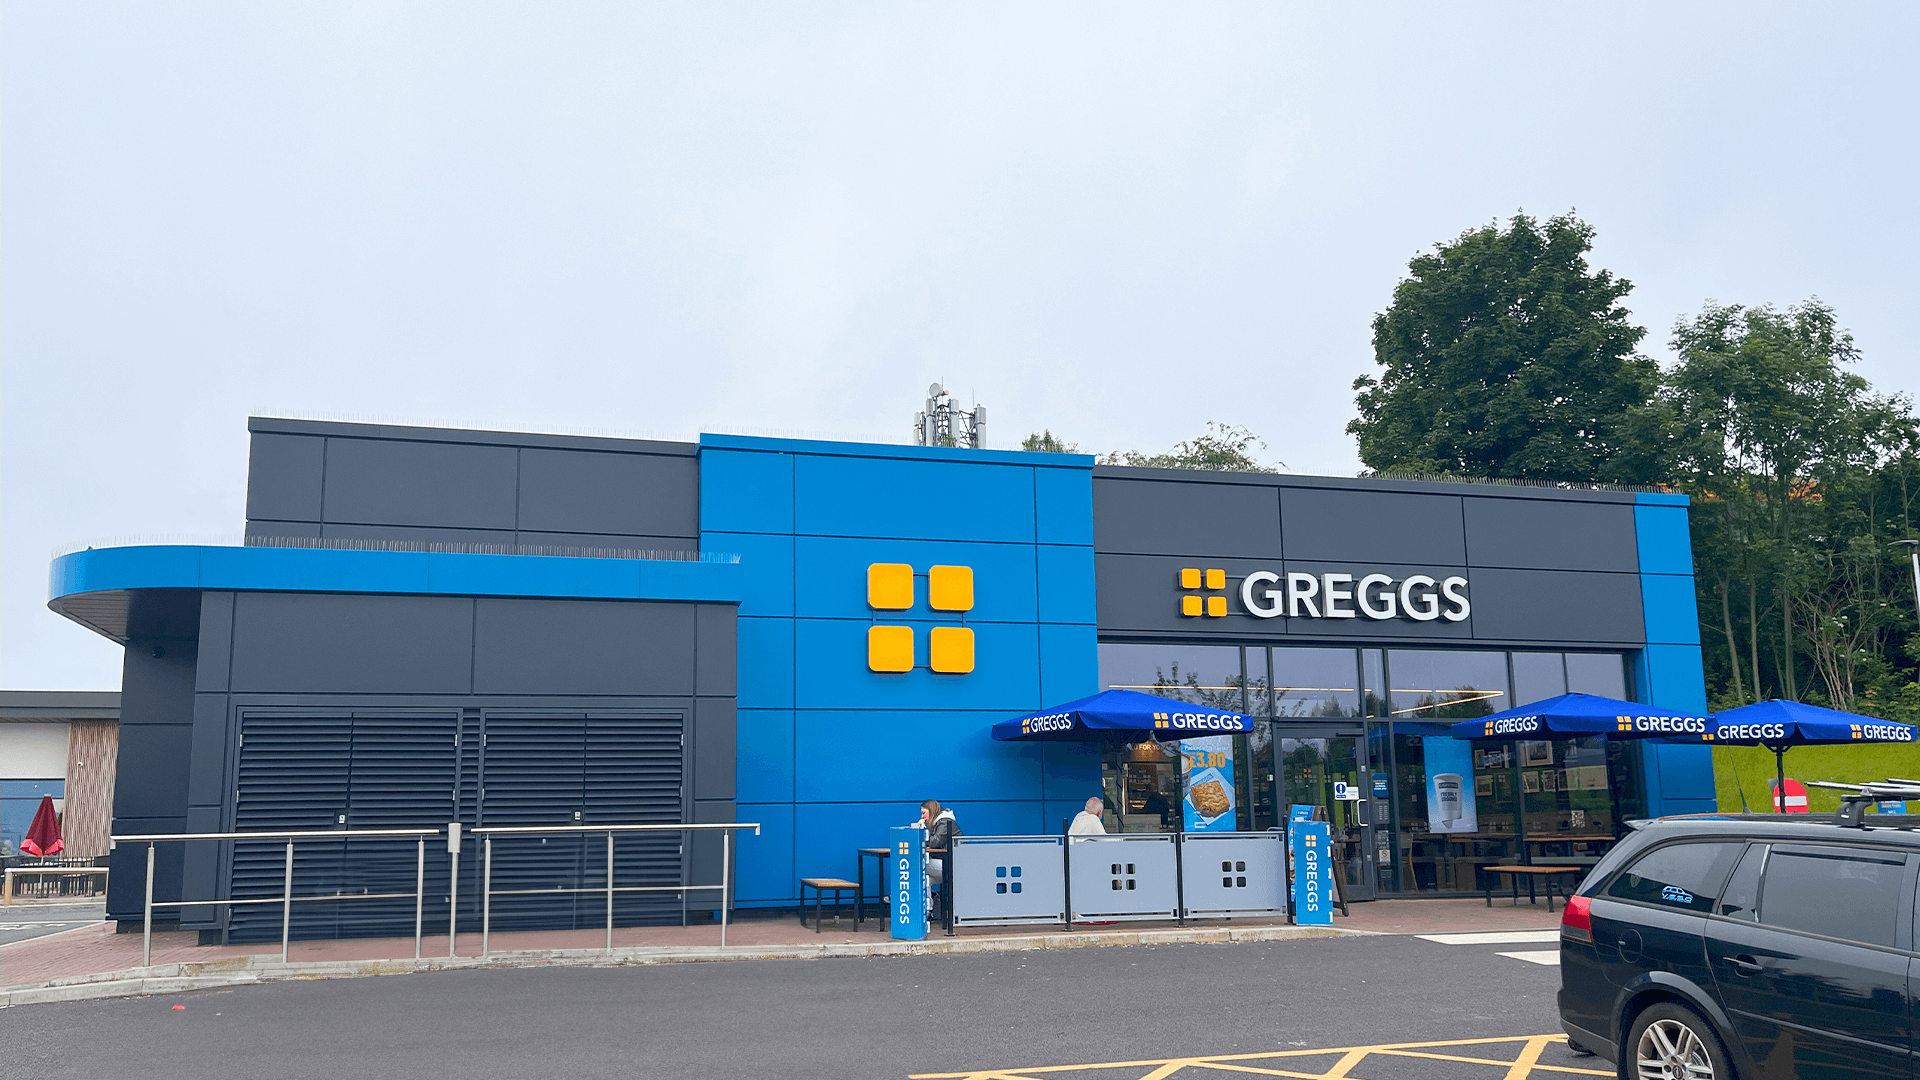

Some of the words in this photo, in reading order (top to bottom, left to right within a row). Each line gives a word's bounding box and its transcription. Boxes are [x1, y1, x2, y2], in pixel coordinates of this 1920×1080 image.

[1241, 570, 1471, 622] GREGGS
[1031, 712, 1072, 733] GREGGS
[1172, 712, 1244, 730] GREGGS
[1495, 715, 1539, 734] GREGGS
[1635, 715, 1706, 733] GREGGS
[1717, 723, 1785, 740] GREGGS
[1863, 724, 1912, 742] GREGGS
[1188, 751, 1227, 768] £3.80
[1306, 850, 1318, 912] GREGGS
[899, 858, 910, 925] GREGGS
